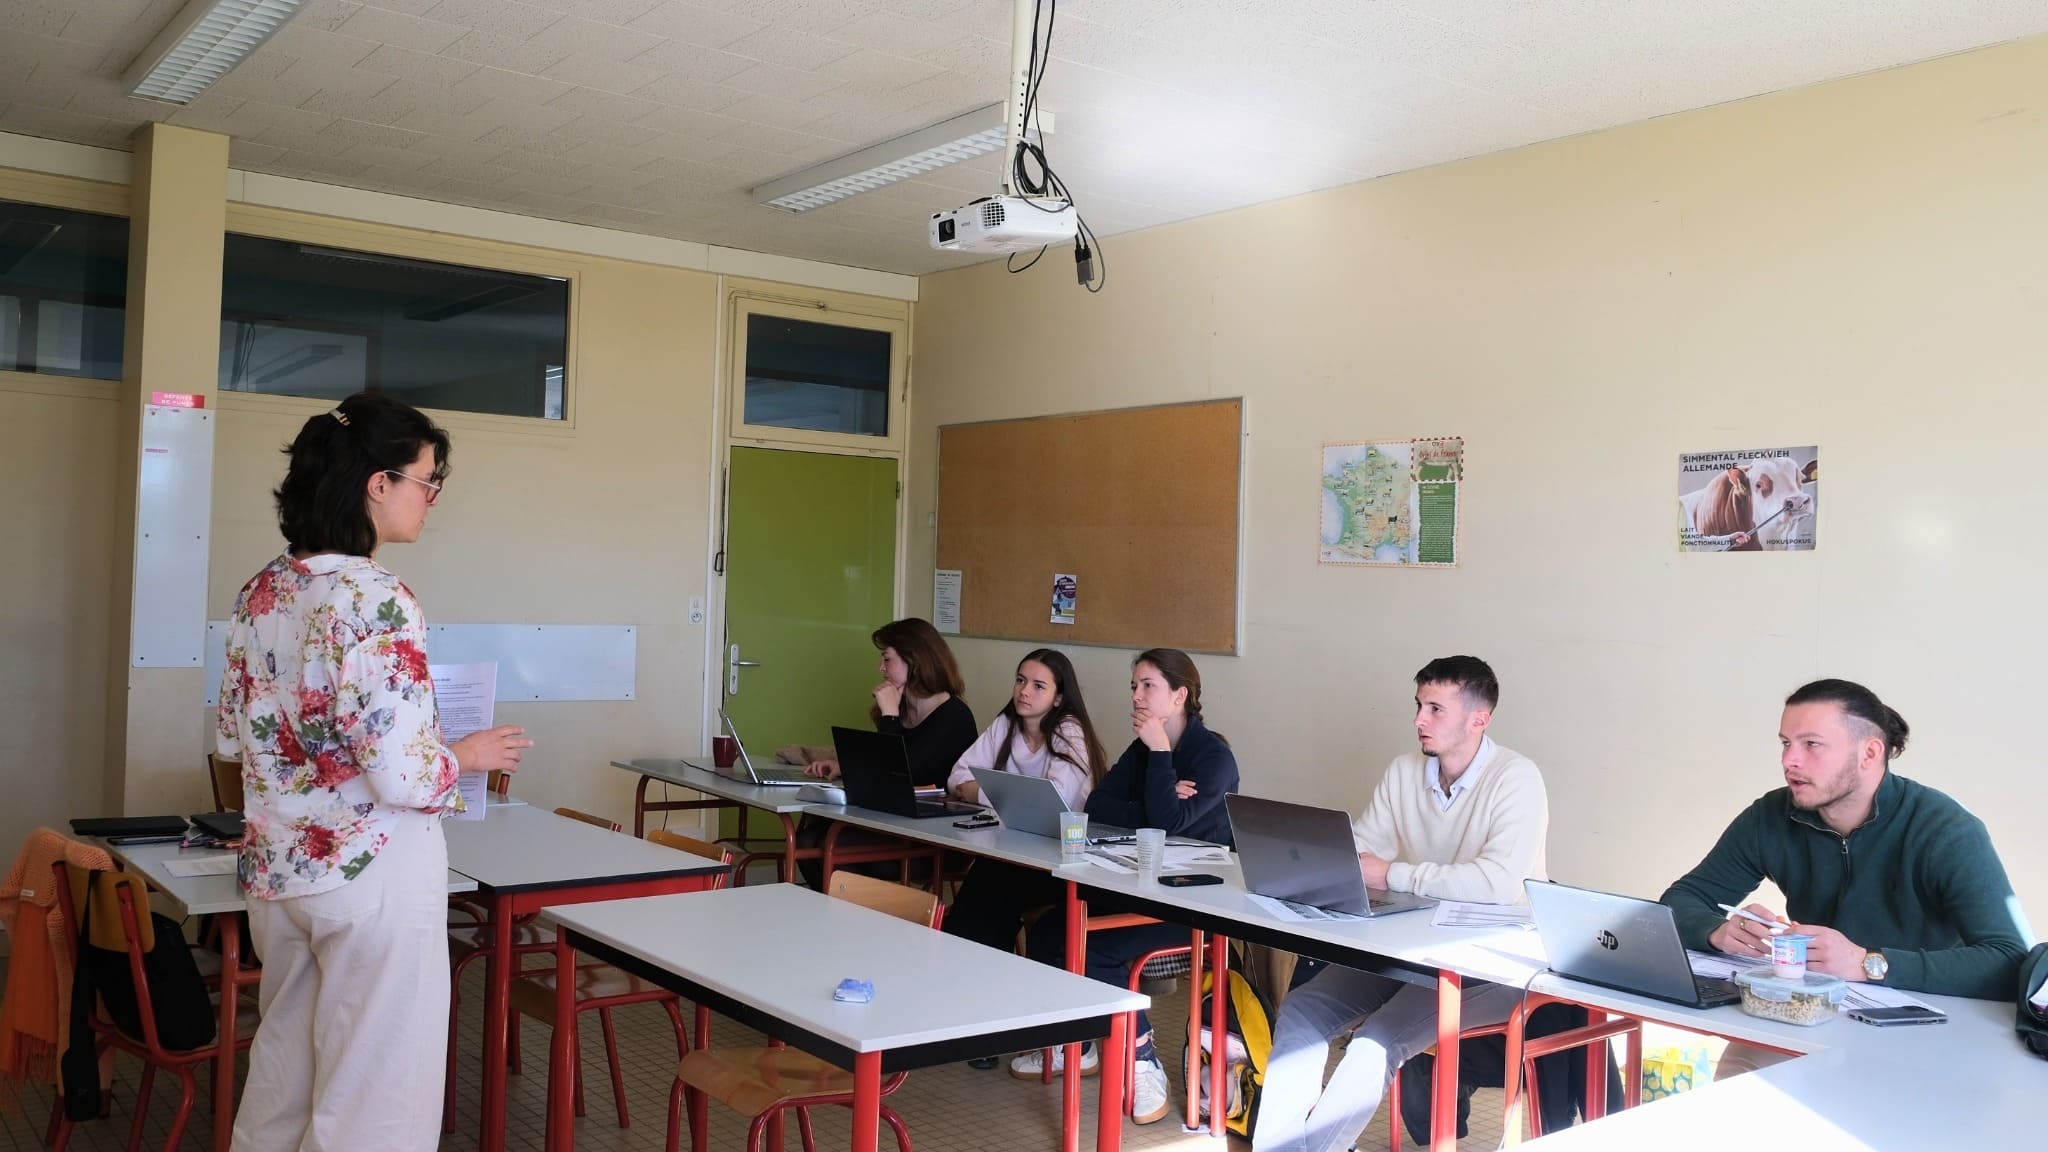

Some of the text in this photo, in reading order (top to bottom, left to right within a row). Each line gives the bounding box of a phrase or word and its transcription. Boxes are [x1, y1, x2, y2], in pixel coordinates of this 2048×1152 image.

[1683, 450, 1790, 463] SIMMENTAL FLECKVIEH
[1683, 462, 1738, 472] ALLEMANDE
[1067, 829, 1083, 839] 100
[1600, 929, 1617, 950] hp
